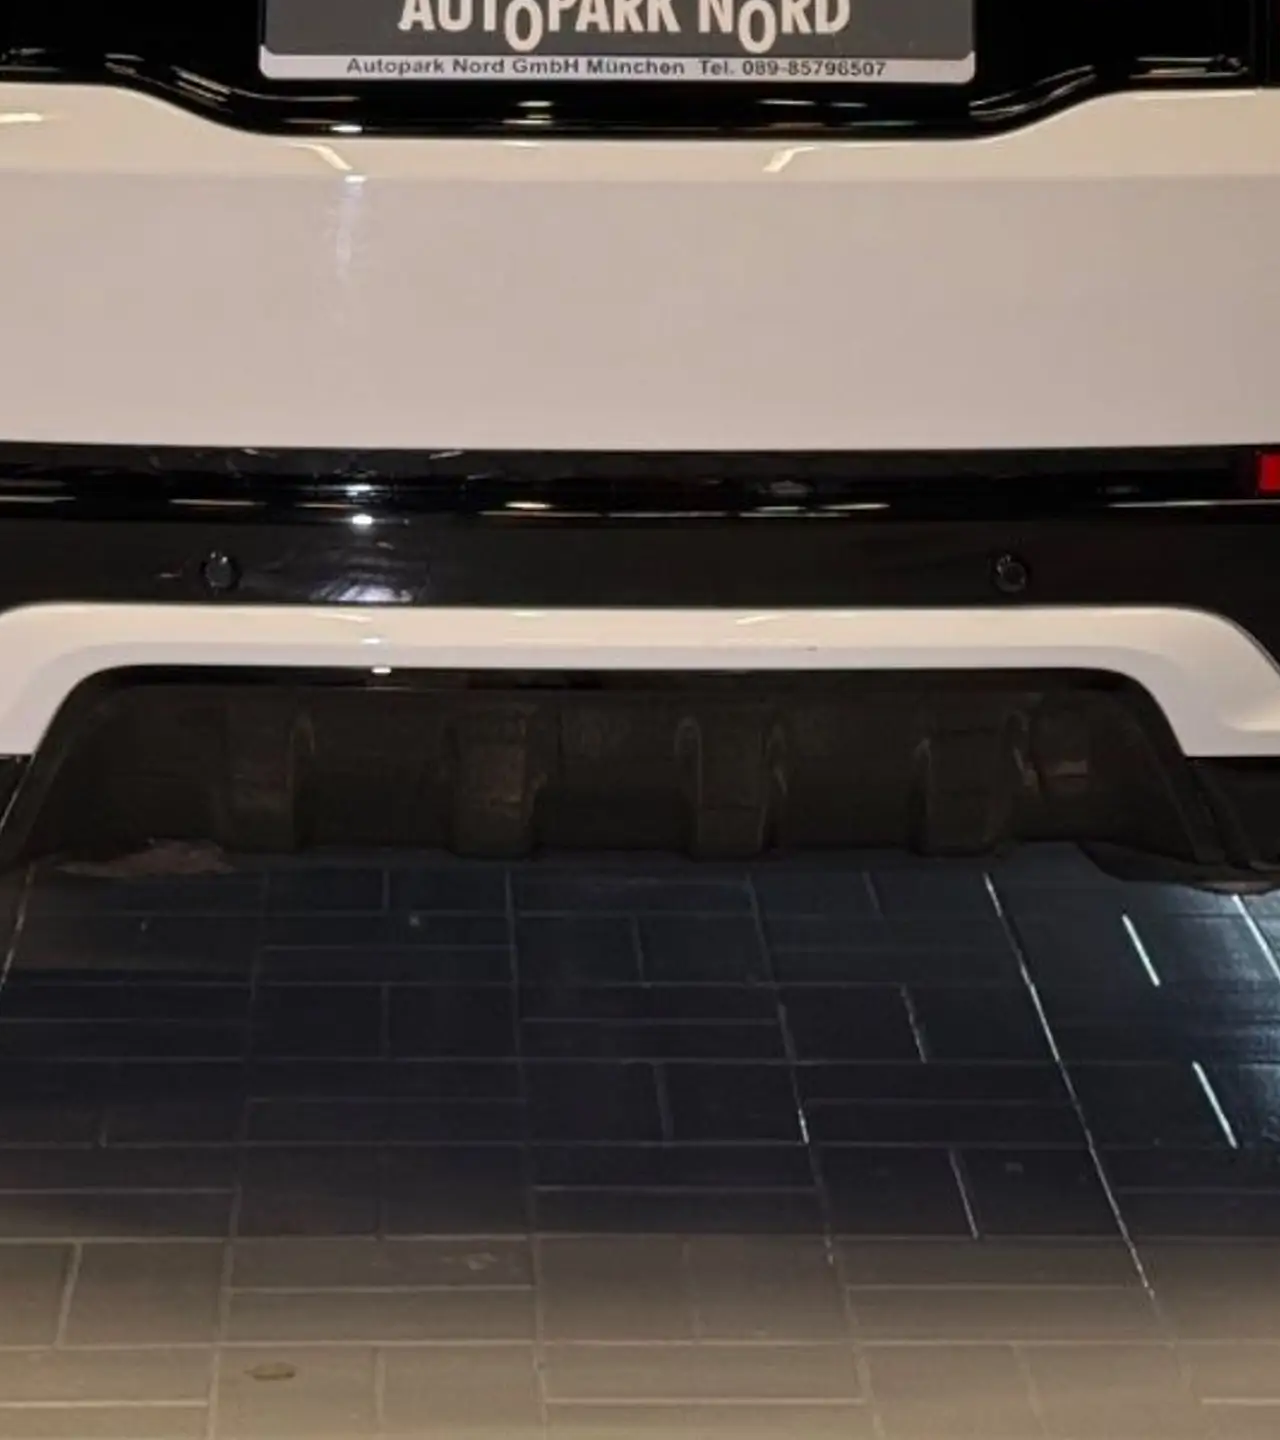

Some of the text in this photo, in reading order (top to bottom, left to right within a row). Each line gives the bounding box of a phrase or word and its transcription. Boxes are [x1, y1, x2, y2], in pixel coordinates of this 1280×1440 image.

[346, 57, 445, 77] Autopark
[452, 57, 505, 74] Nord
[512, 58, 580, 75] GmbH
[586, 58, 685, 76] München
[699, 59, 734, 76] Tel.
